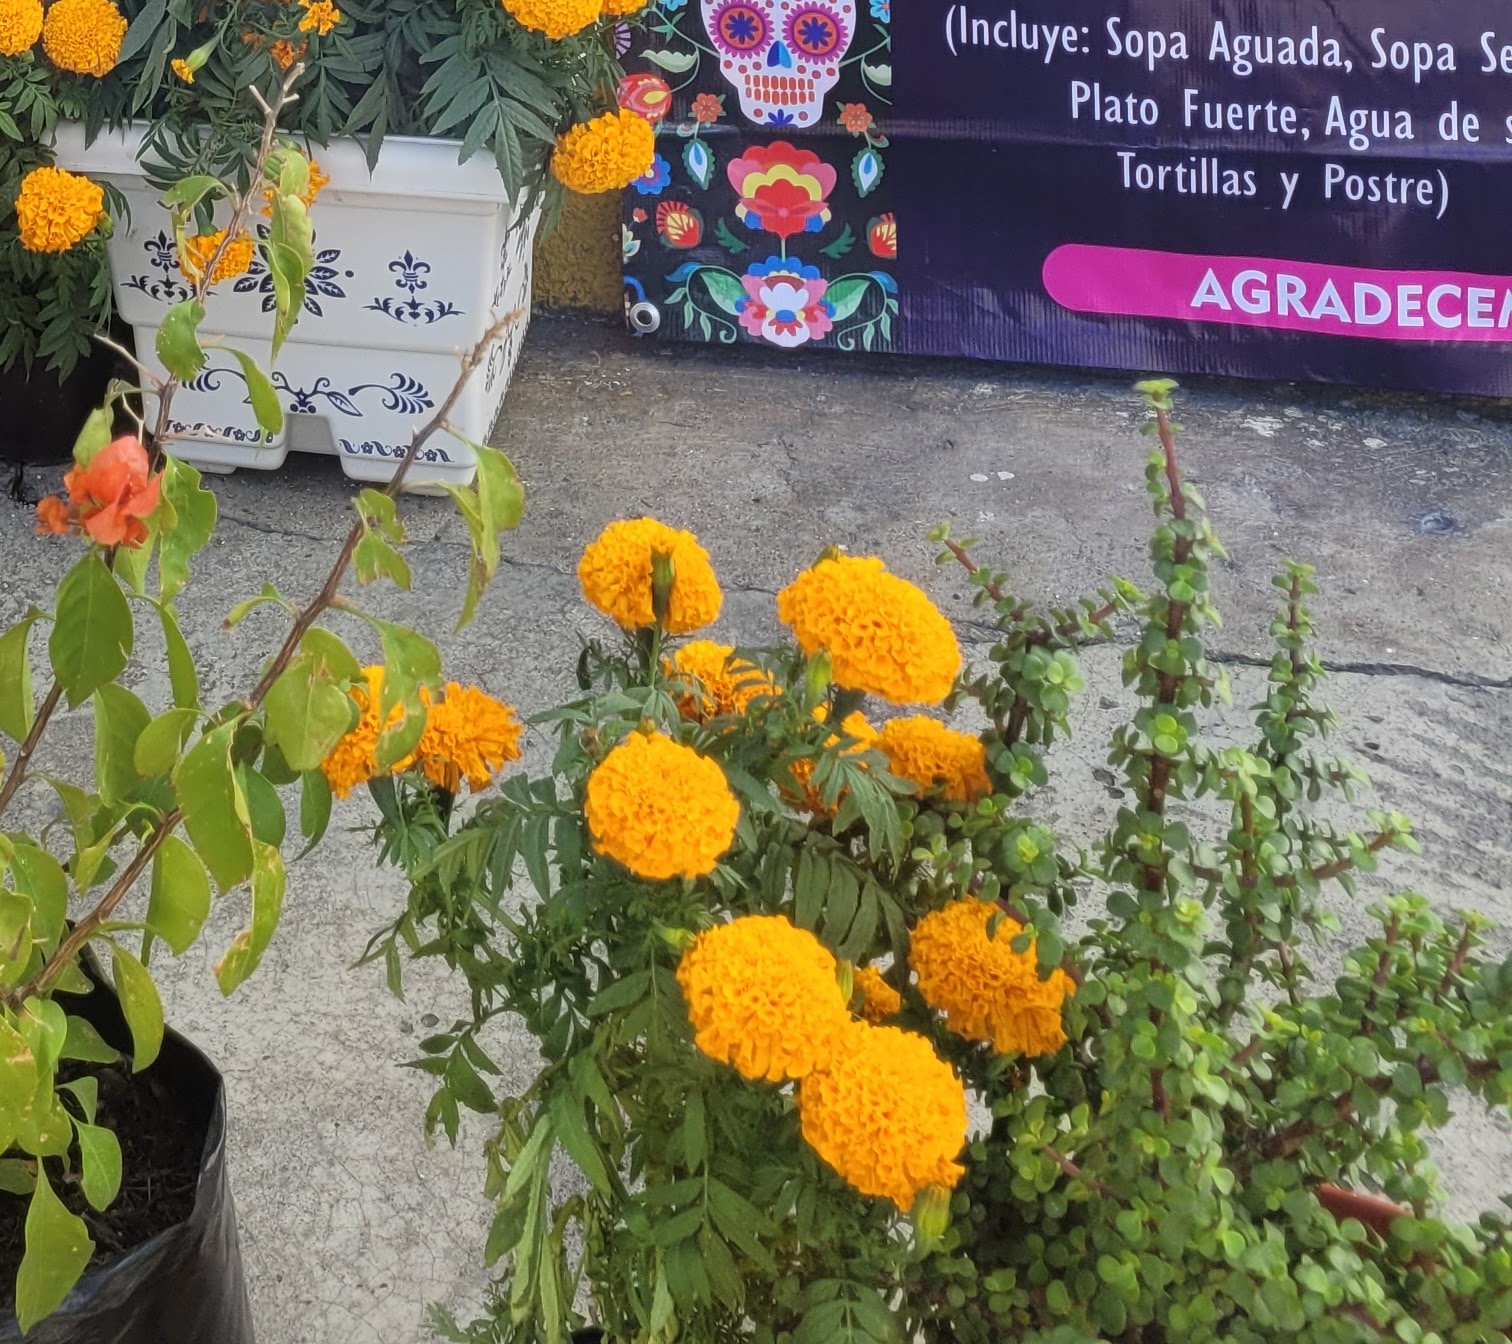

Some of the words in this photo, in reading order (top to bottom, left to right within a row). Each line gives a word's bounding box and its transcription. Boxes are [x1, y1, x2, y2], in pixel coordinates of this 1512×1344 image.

[945, 4, 1090, 64] (Incluye:
[1106, 16, 1190, 72] Sopa
[1208, 20, 1353, 76] Aguada,
[1370, 27, 1457, 84] Sopa
[1071, 80, 1159, 126] Plato
[1184, 88, 1310, 141] Fuerte,
[1324, 95, 1415, 152] Agua
[1438, 100, 1480, 143] de
[1116, 151, 1257, 196] Tortillas
[1279, 172, 1299, 210] y
[1325, 163, 1449, 220] Postre)
